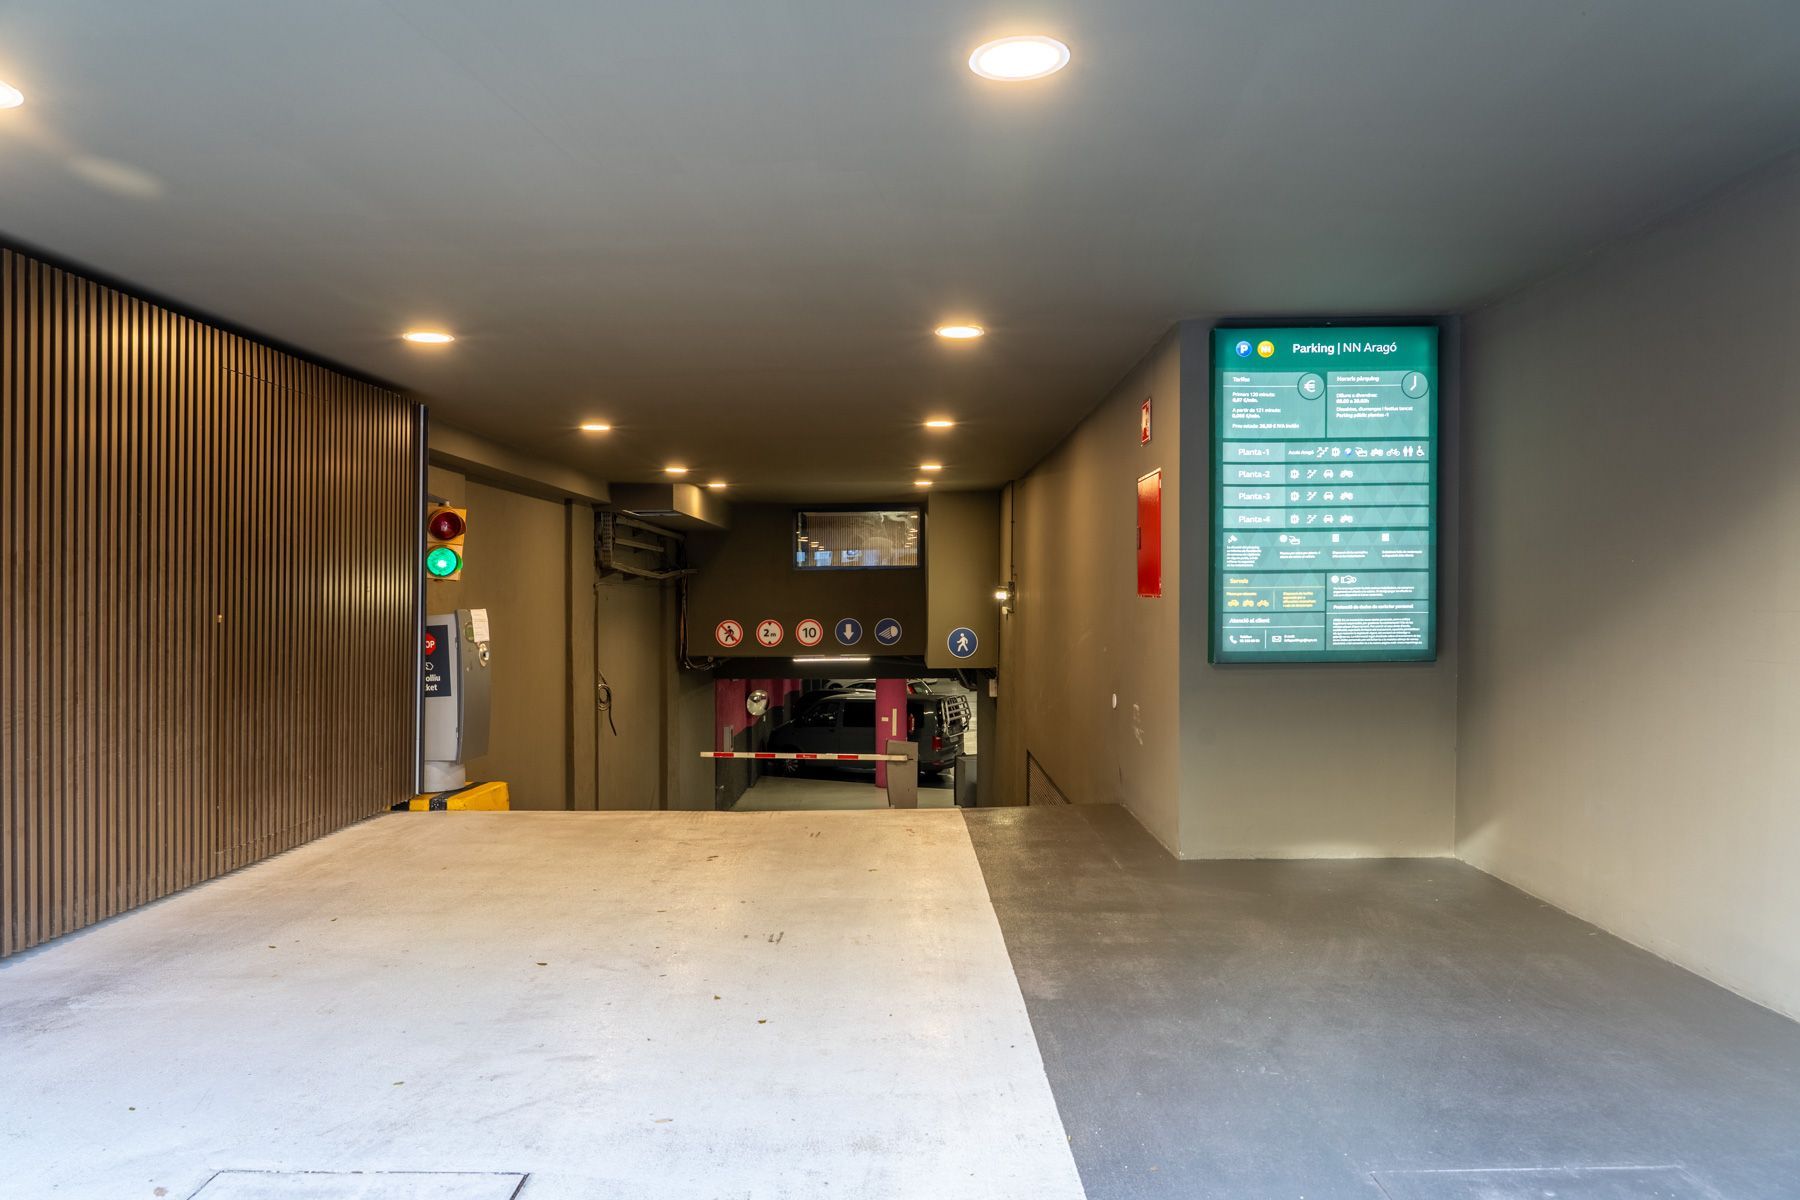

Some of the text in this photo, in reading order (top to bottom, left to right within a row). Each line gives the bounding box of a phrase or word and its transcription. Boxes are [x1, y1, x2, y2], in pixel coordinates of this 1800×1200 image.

[1292, 343, 1334, 355] Parking
[1342, 343, 1361, 352] NN
[1364, 342, 1397, 354] Aragó
[764, 629, 769, 637] 2
[802, 627, 817, 638] 10
[426, 640, 435, 649] OP
